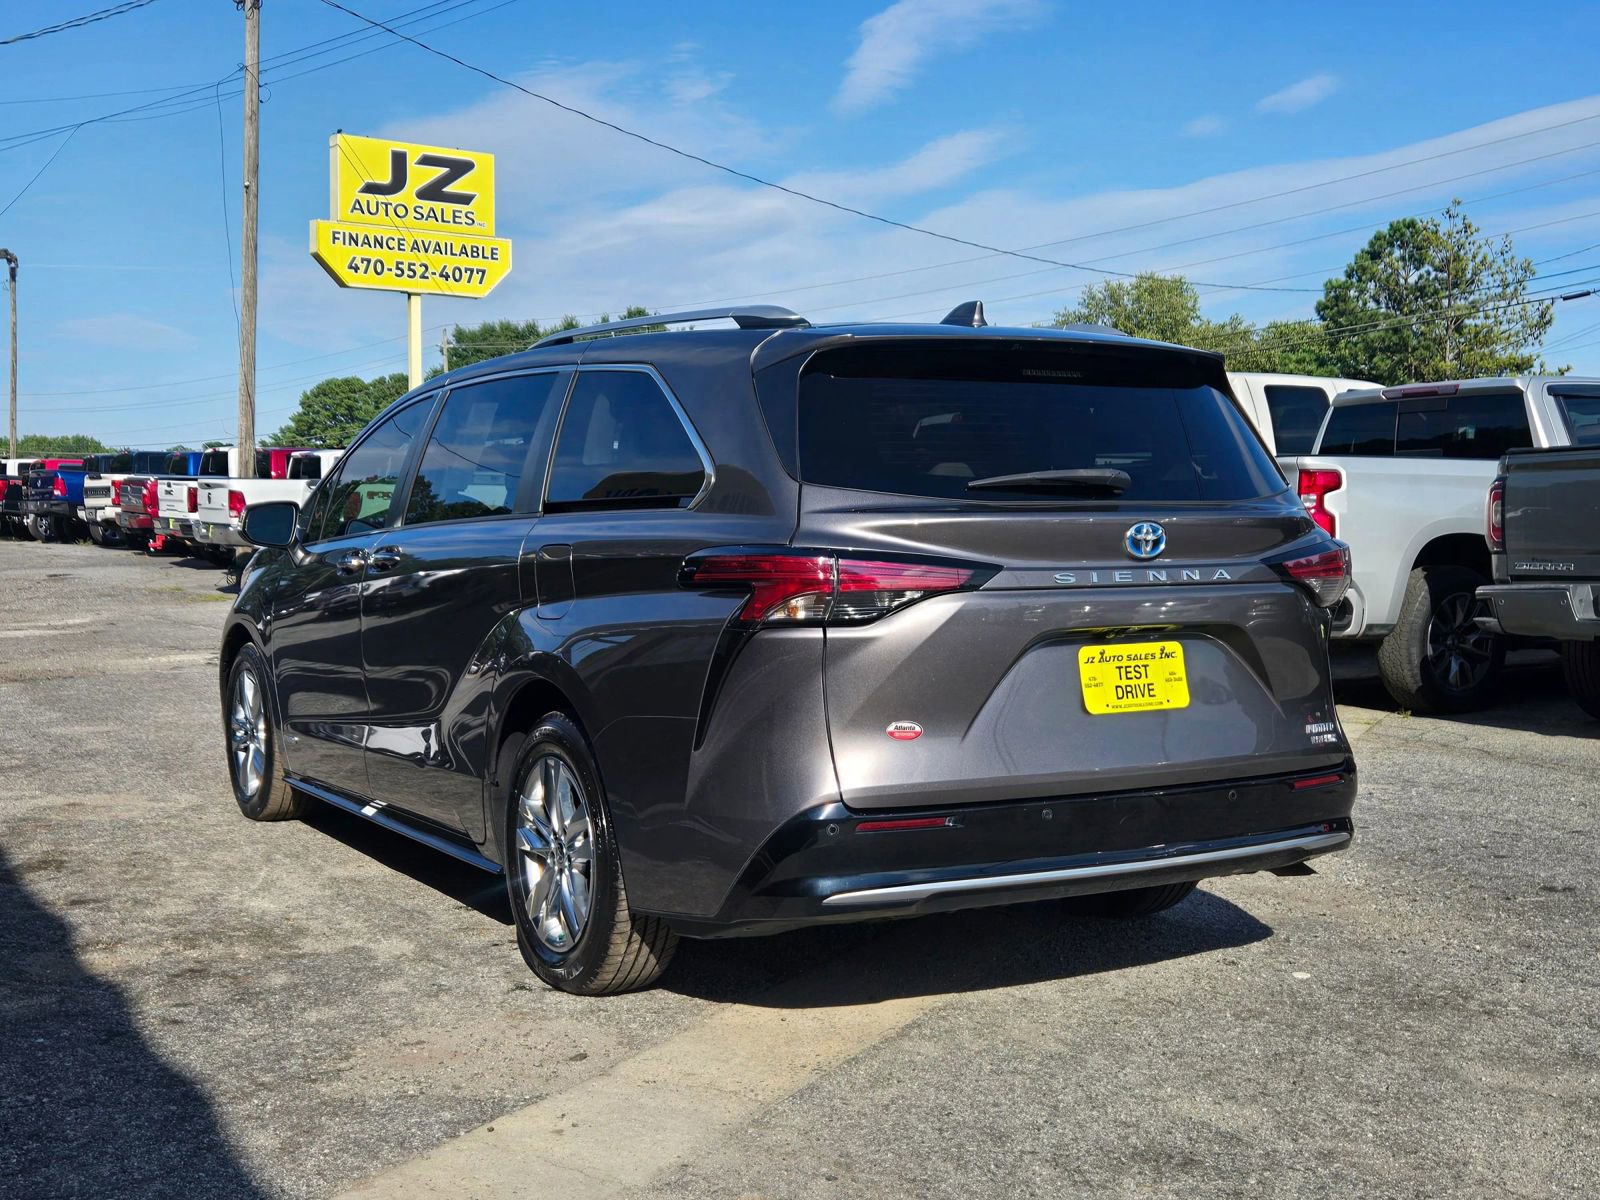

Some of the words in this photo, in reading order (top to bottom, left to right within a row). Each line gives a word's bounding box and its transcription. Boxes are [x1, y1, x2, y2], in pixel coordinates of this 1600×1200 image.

[357, 149, 478, 206] JZ
[350, 198, 409, 219] AUTO
[413, 205, 476, 226] SALES
[331, 230, 406, 251] FINANCE
[410, 239, 499, 261] AVAILABLE
[347, 256, 487, 285] 470-552-4077
[1053, 569, 1232, 584] SIENNA
[1083, 656, 1096, 664] JZ
[1098, 652, 1124, 663] AUTO
[1126, 652, 1156, 662] SALES
[1115, 664, 1150, 681] TEST
[1115, 683, 1156, 700] DRIVE
